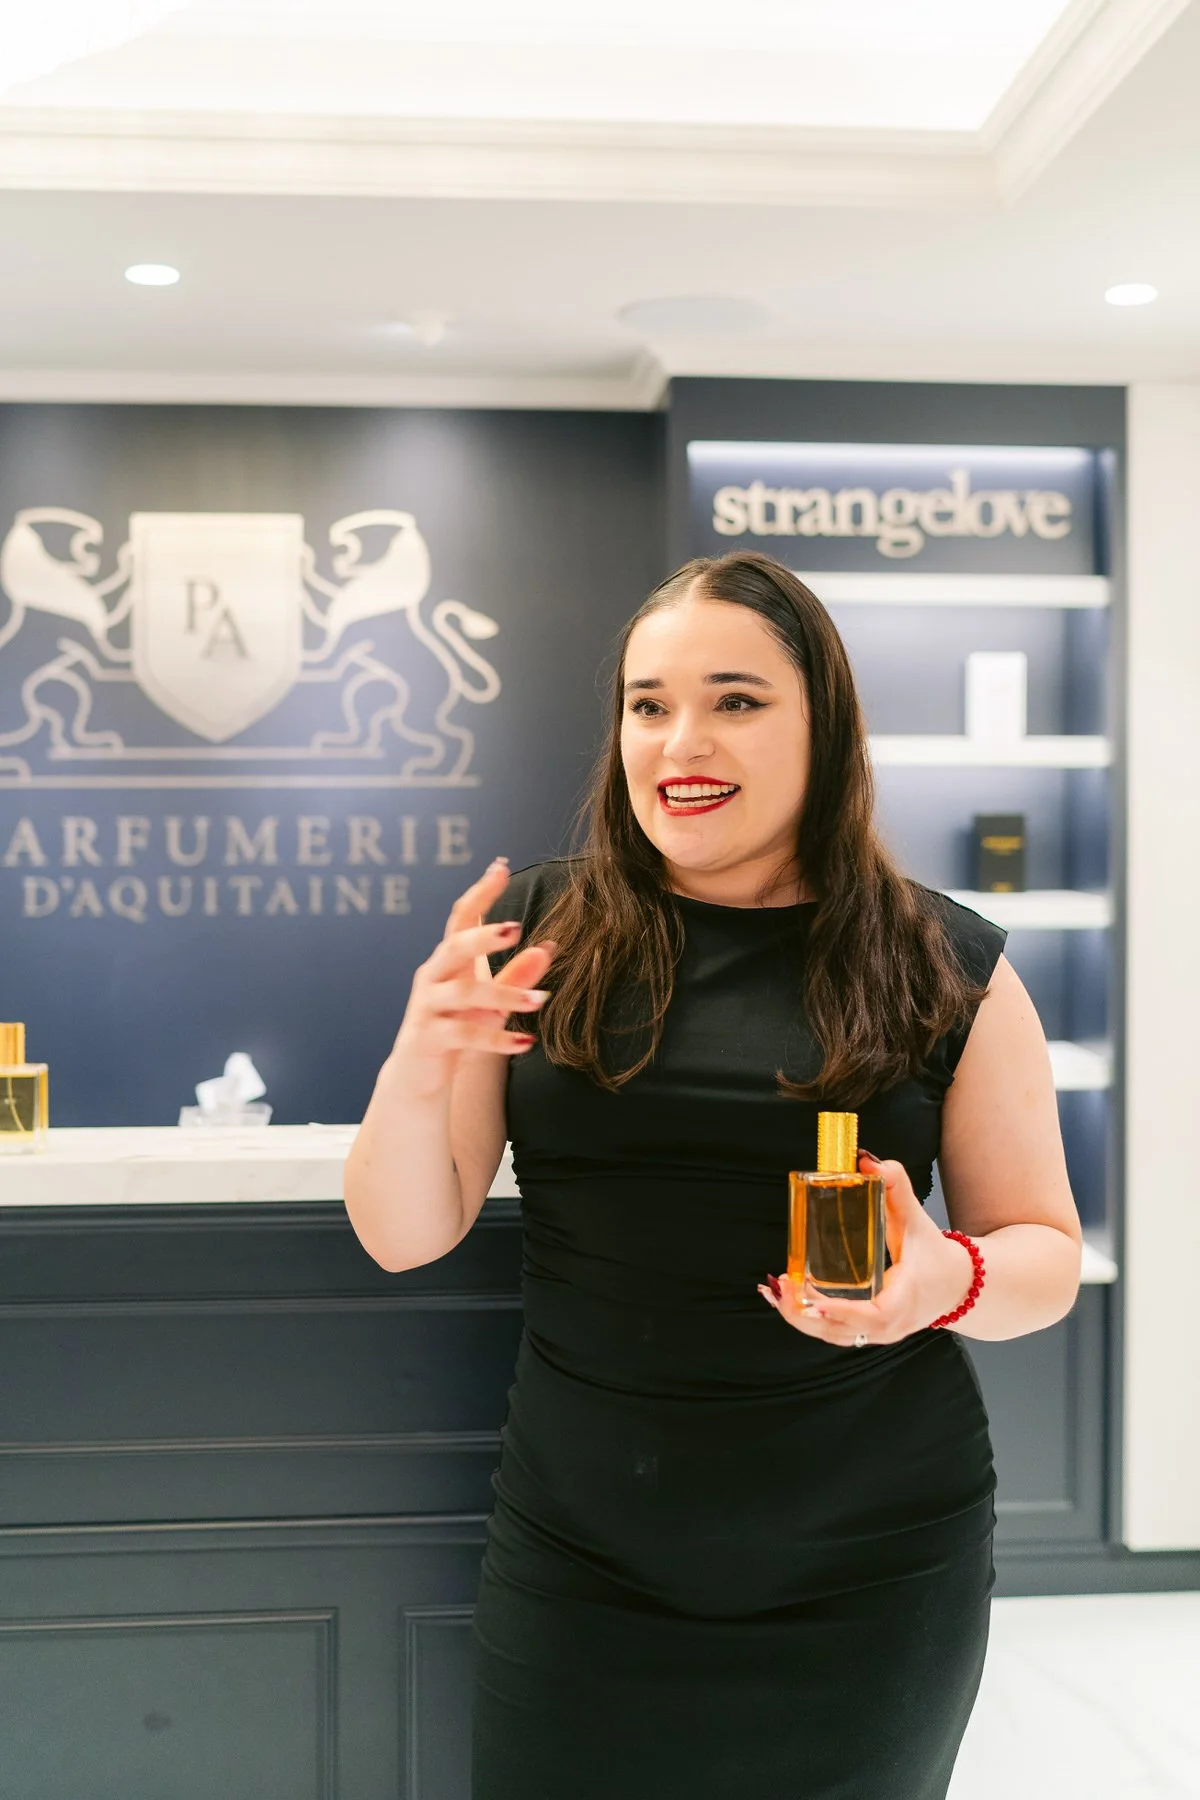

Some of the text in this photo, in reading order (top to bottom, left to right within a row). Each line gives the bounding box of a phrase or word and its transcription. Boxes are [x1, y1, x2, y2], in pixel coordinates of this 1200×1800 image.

[713, 469, 1072, 558] strangelove
[2, 815, 472, 867] ARFUMERIE
[23, 876, 412, 923] D'AQUITAINE
